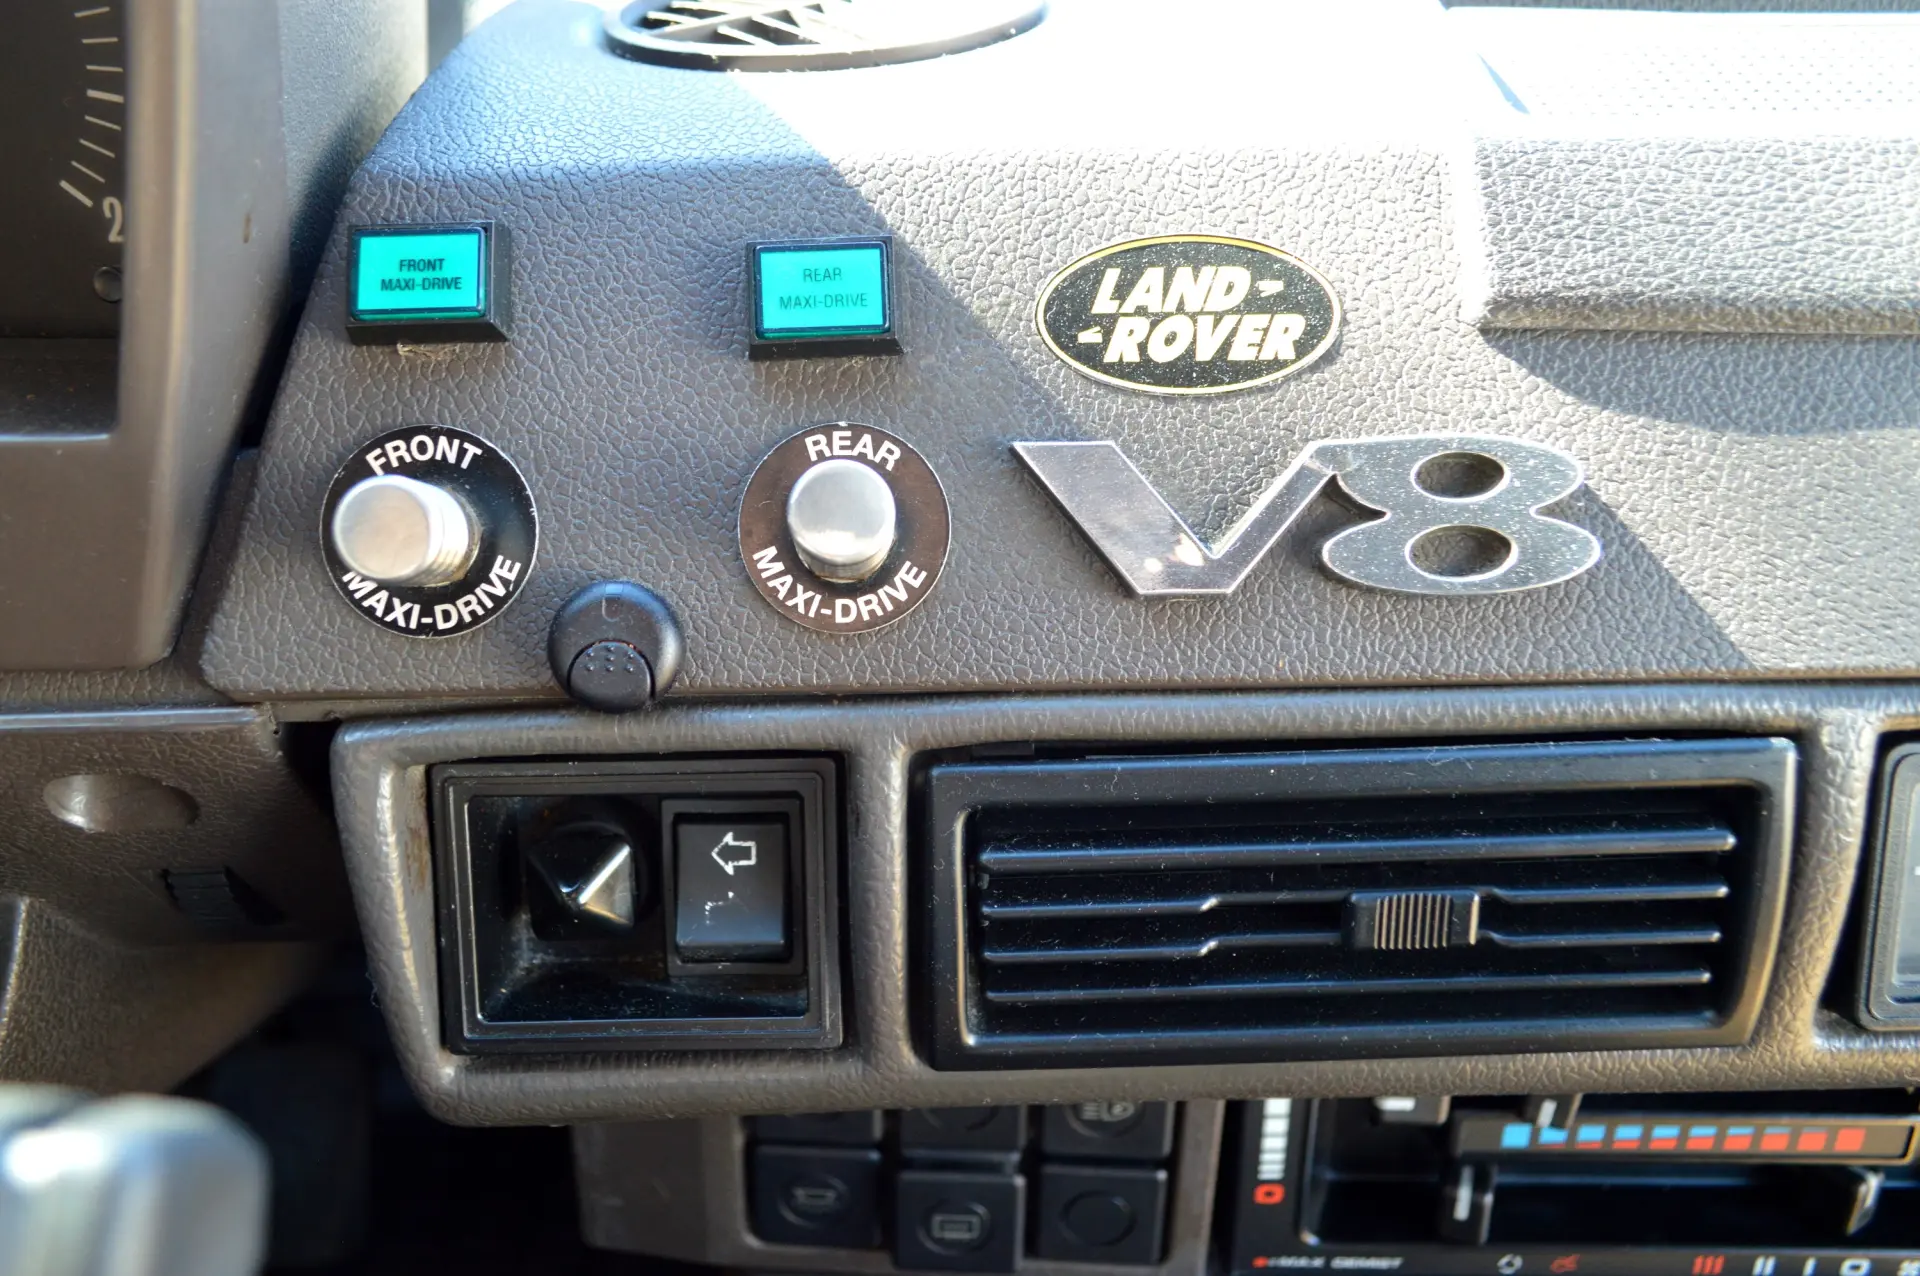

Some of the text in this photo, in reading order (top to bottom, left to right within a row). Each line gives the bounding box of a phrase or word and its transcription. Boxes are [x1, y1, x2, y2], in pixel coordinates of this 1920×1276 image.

[381, 277, 462, 291] MAXI-DRIVE
[399, 258, 445, 272] FRONT
[803, 267, 842, 283] REAR
[779, 293, 868, 310] MAXI-DRIVE
[365, 435, 483, 476] FRONT
[805, 431, 901, 472] REAR
[1010, 433, 1601, 596] V8
[341, 555, 522, 630] MAXI-DRIVE
[752, 545, 927, 624] MAXI-DRIVE
